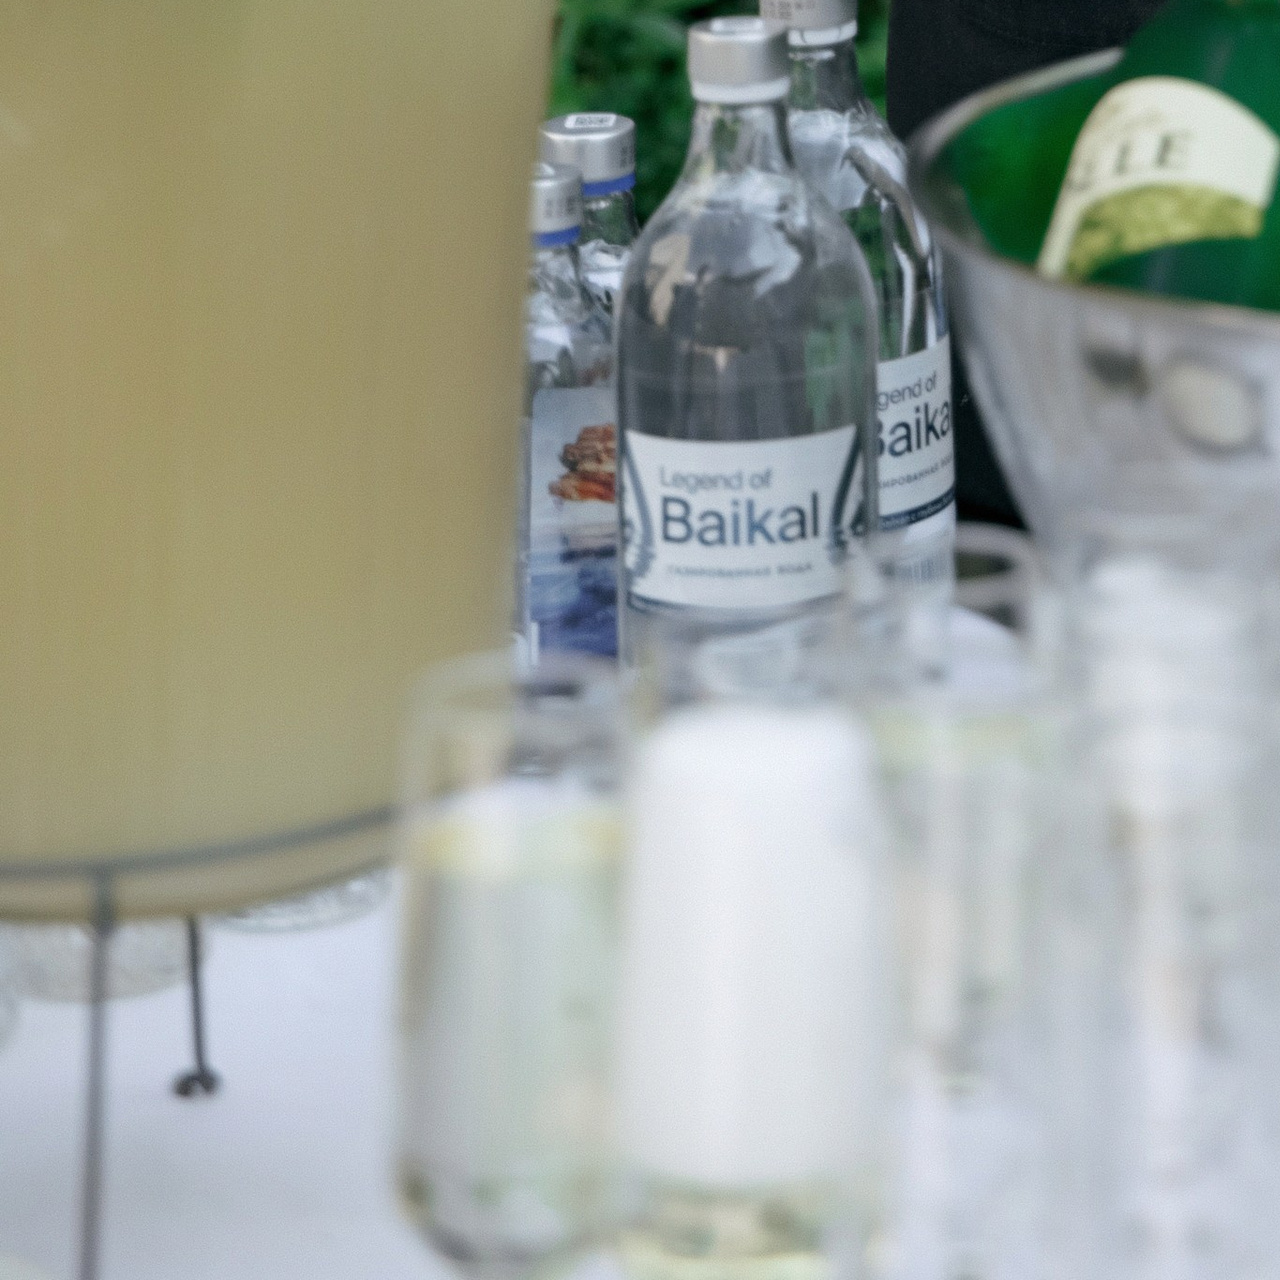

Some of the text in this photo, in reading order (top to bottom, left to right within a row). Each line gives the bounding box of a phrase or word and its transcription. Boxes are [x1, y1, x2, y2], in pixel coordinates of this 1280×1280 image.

[877, 376, 922, 411] gend
[877, 400, 951, 458] aika
[660, 464, 773, 495] Legend of
[662, 491, 819, 547] Baikal
